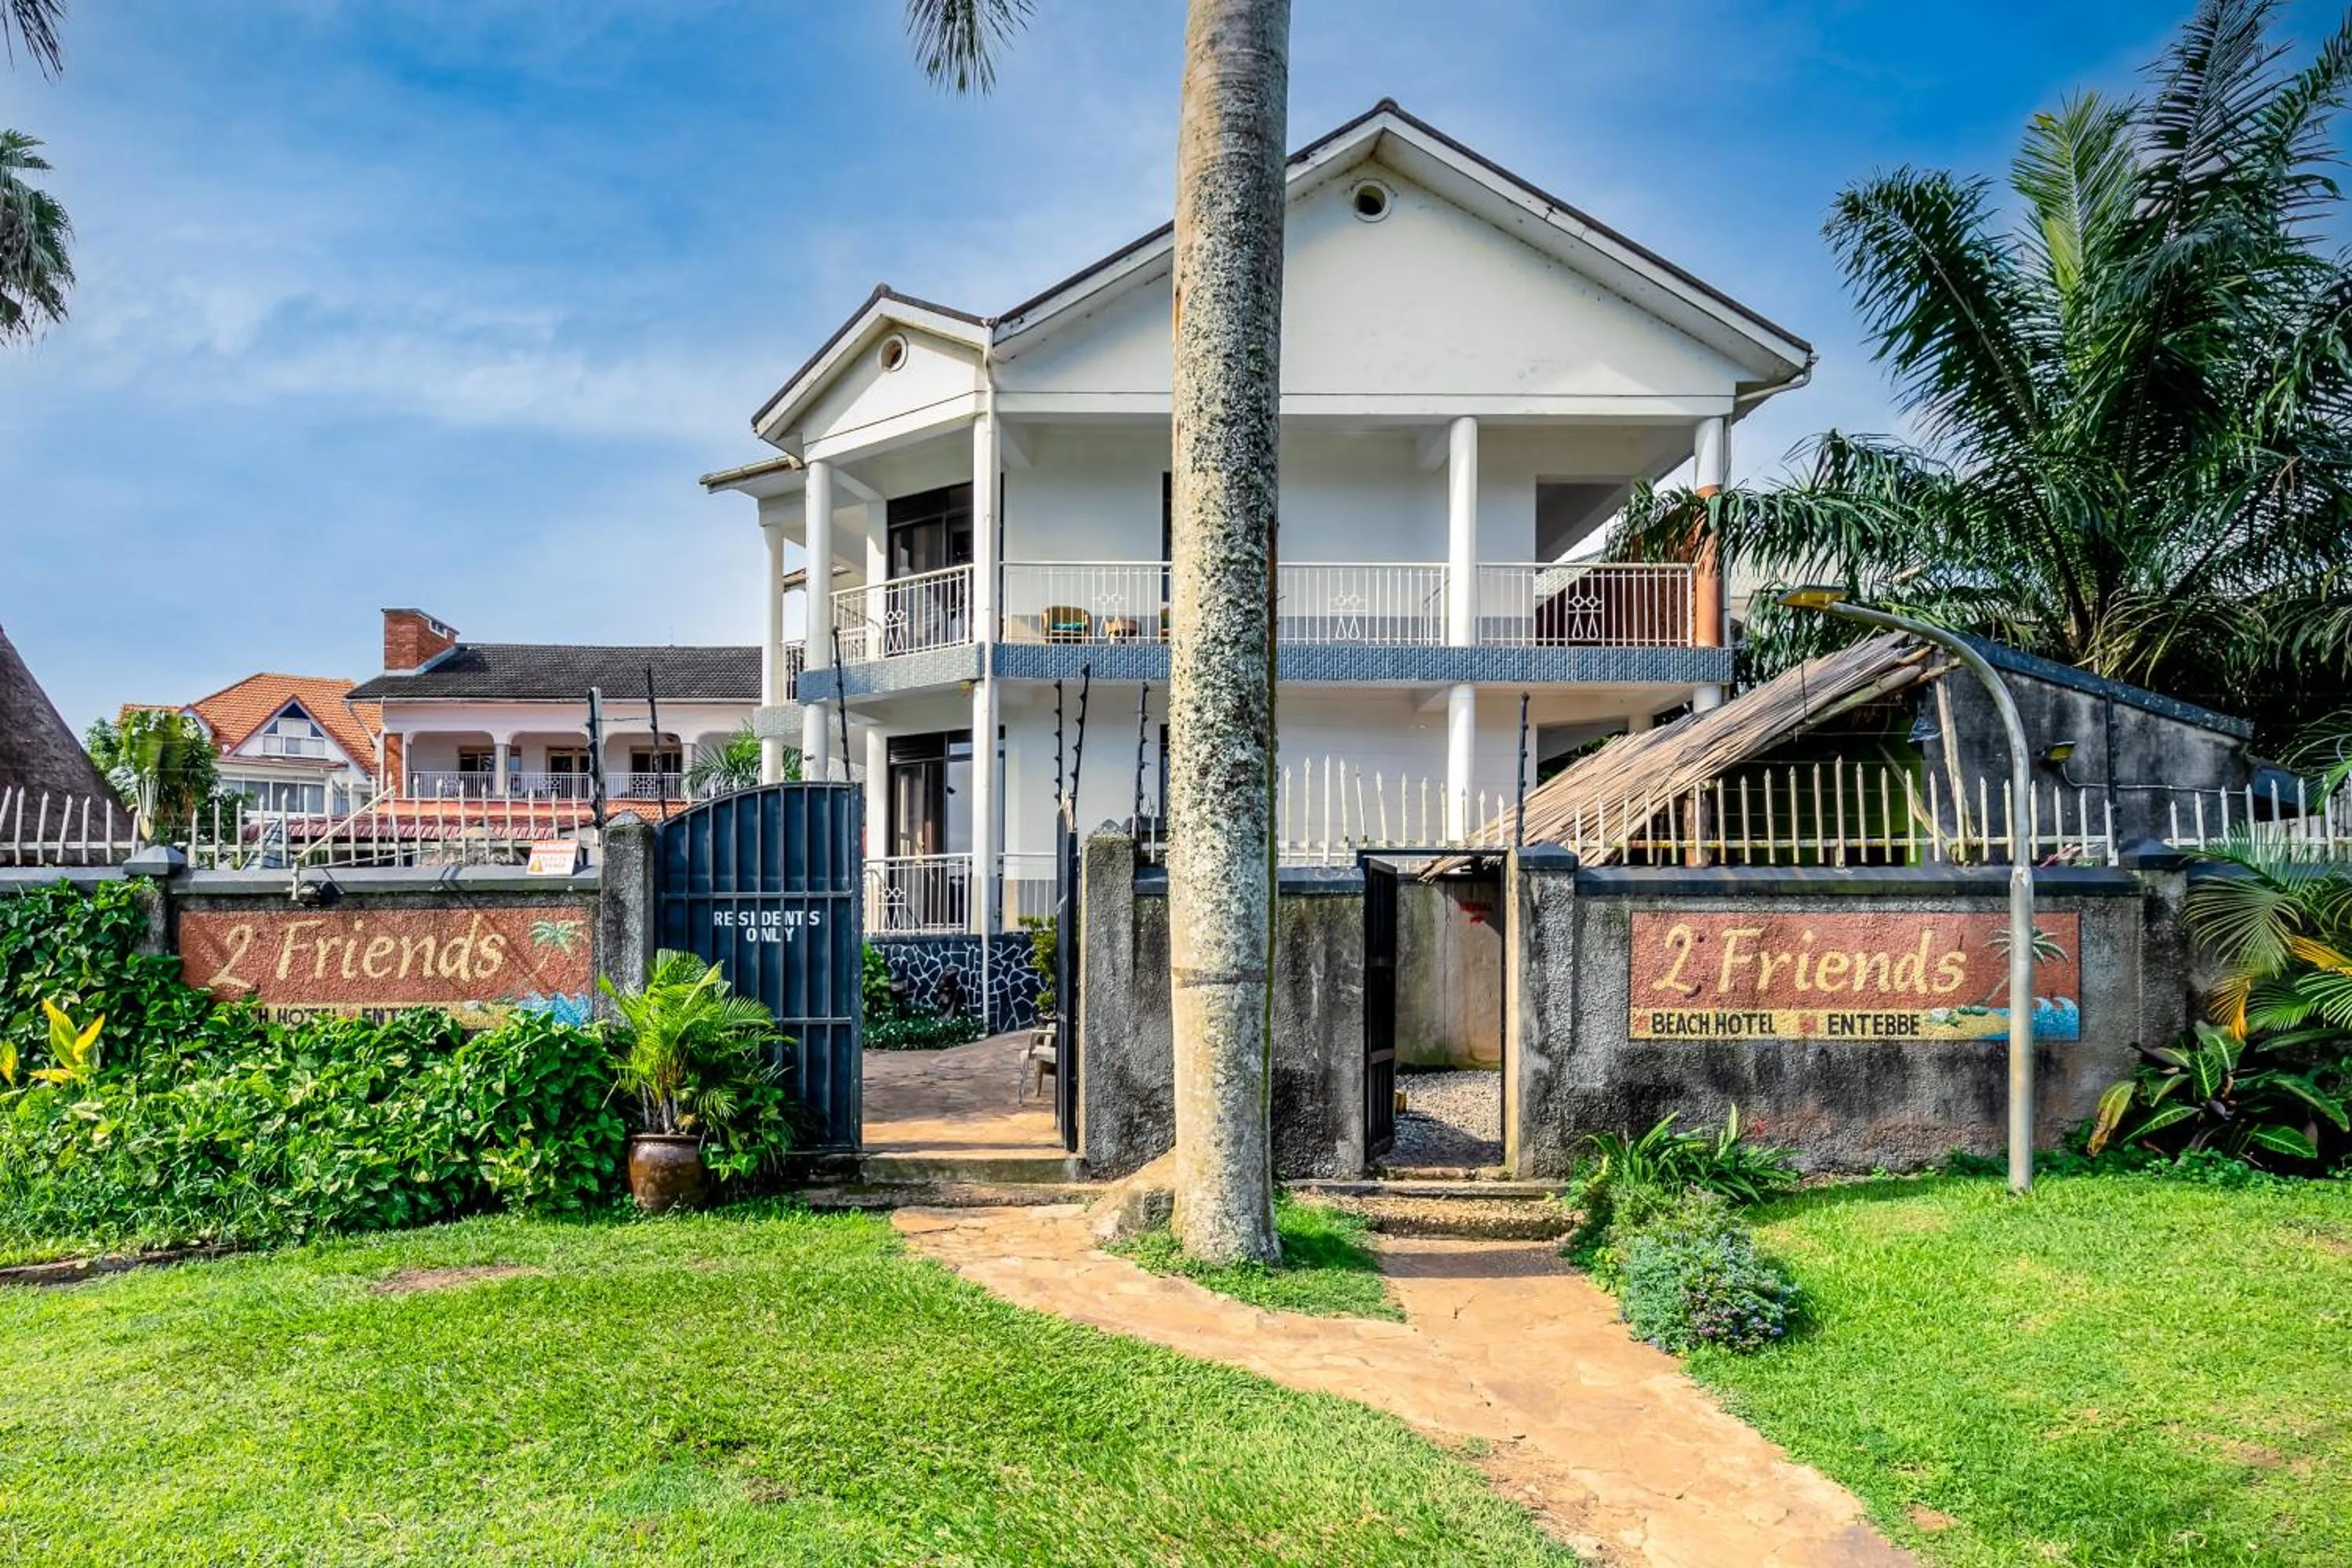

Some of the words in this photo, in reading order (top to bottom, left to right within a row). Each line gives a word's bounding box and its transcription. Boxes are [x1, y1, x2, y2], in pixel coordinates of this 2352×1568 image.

[713, 911, 821, 926] RESIDENTS
[746, 927, 795, 942] ONLY
[209, 924, 255, 989] 2
[275, 913, 506, 982] Friends
[1653, 923, 1693, 992] 2
[1718, 928, 1968, 995] Friends
[1652, 1012, 1710, 1035] BEACH
[1715, 1012, 1776, 1034] HOTEL
[1828, 1014, 1920, 1035] ENTEBBE
